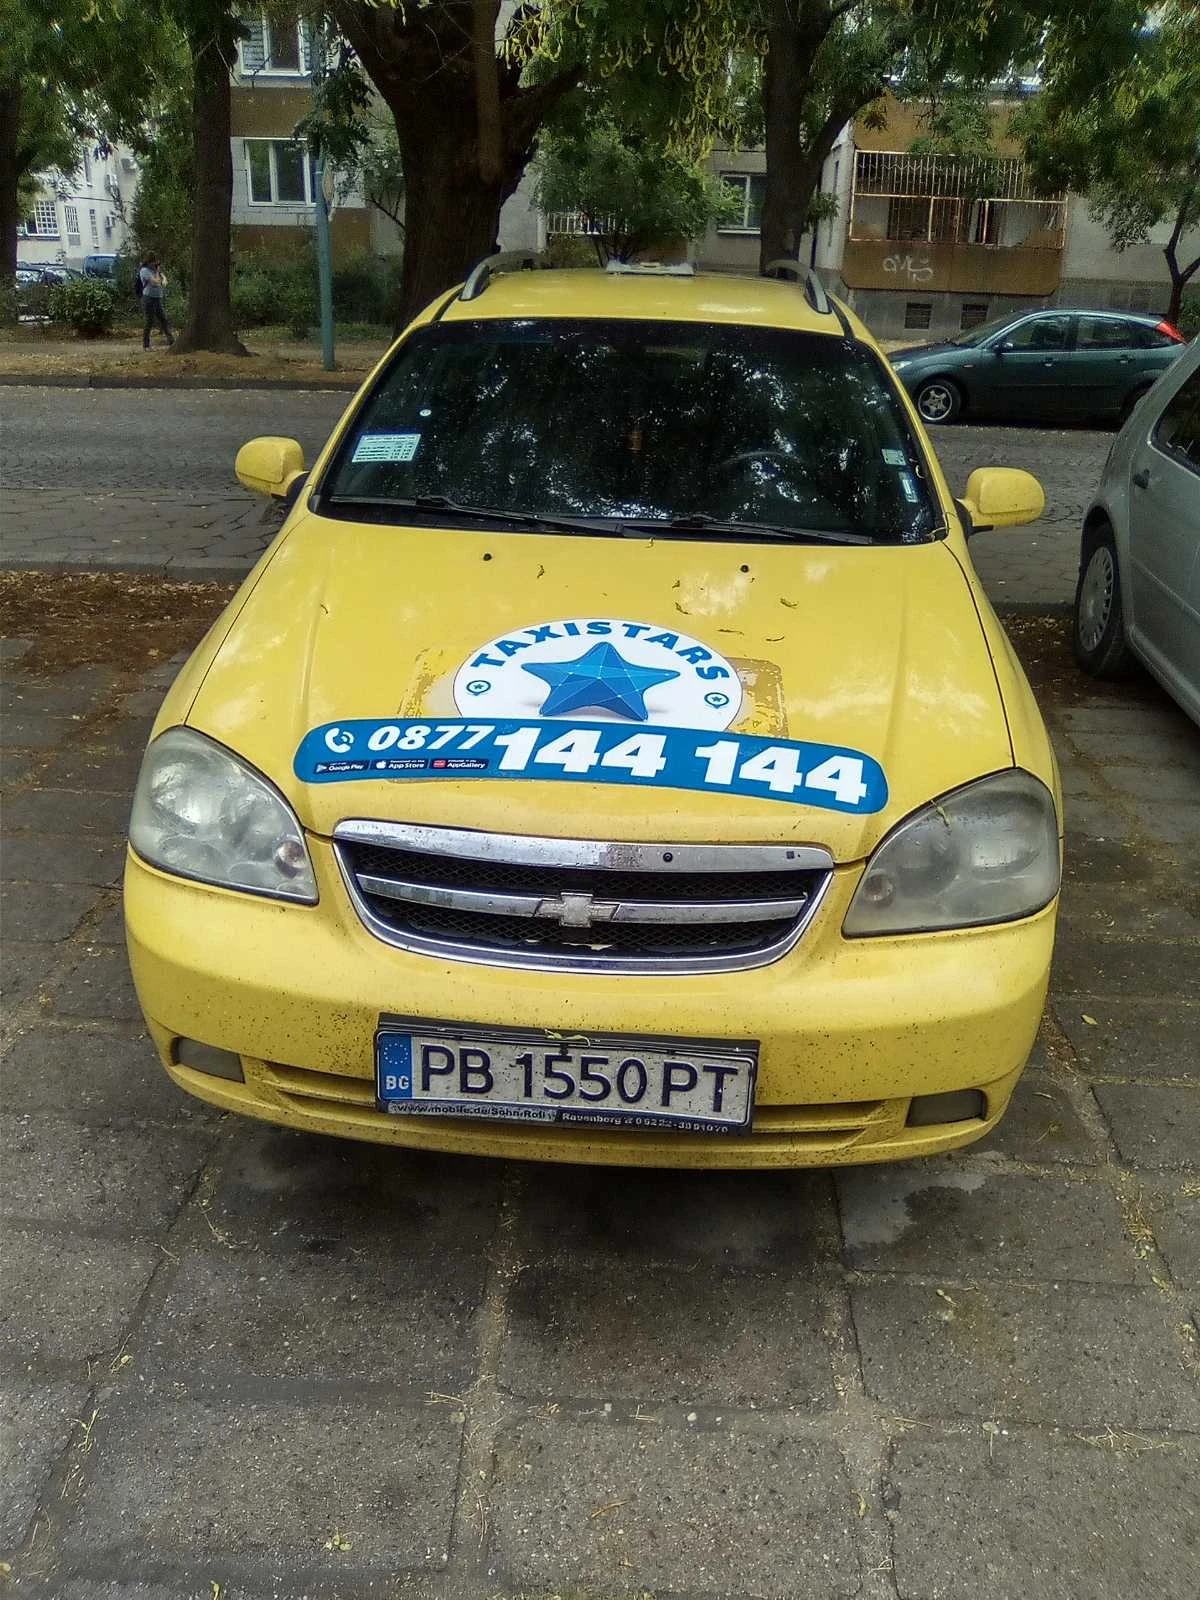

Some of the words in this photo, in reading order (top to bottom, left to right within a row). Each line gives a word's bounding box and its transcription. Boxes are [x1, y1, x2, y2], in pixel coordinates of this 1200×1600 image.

[470, 620, 730, 681] TAXISTARS
[367, 725, 496, 751] 0877
[493, 726, 667, 778] 144
[695, 739, 868, 805] 144
[447, 761, 486, 770] AppGallery
[385, 1075, 410, 1091] BG
[420, 1043, 494, 1095] PB
[515, 1051, 649, 1103] 1550
[660, 1060, 740, 1113] PT
